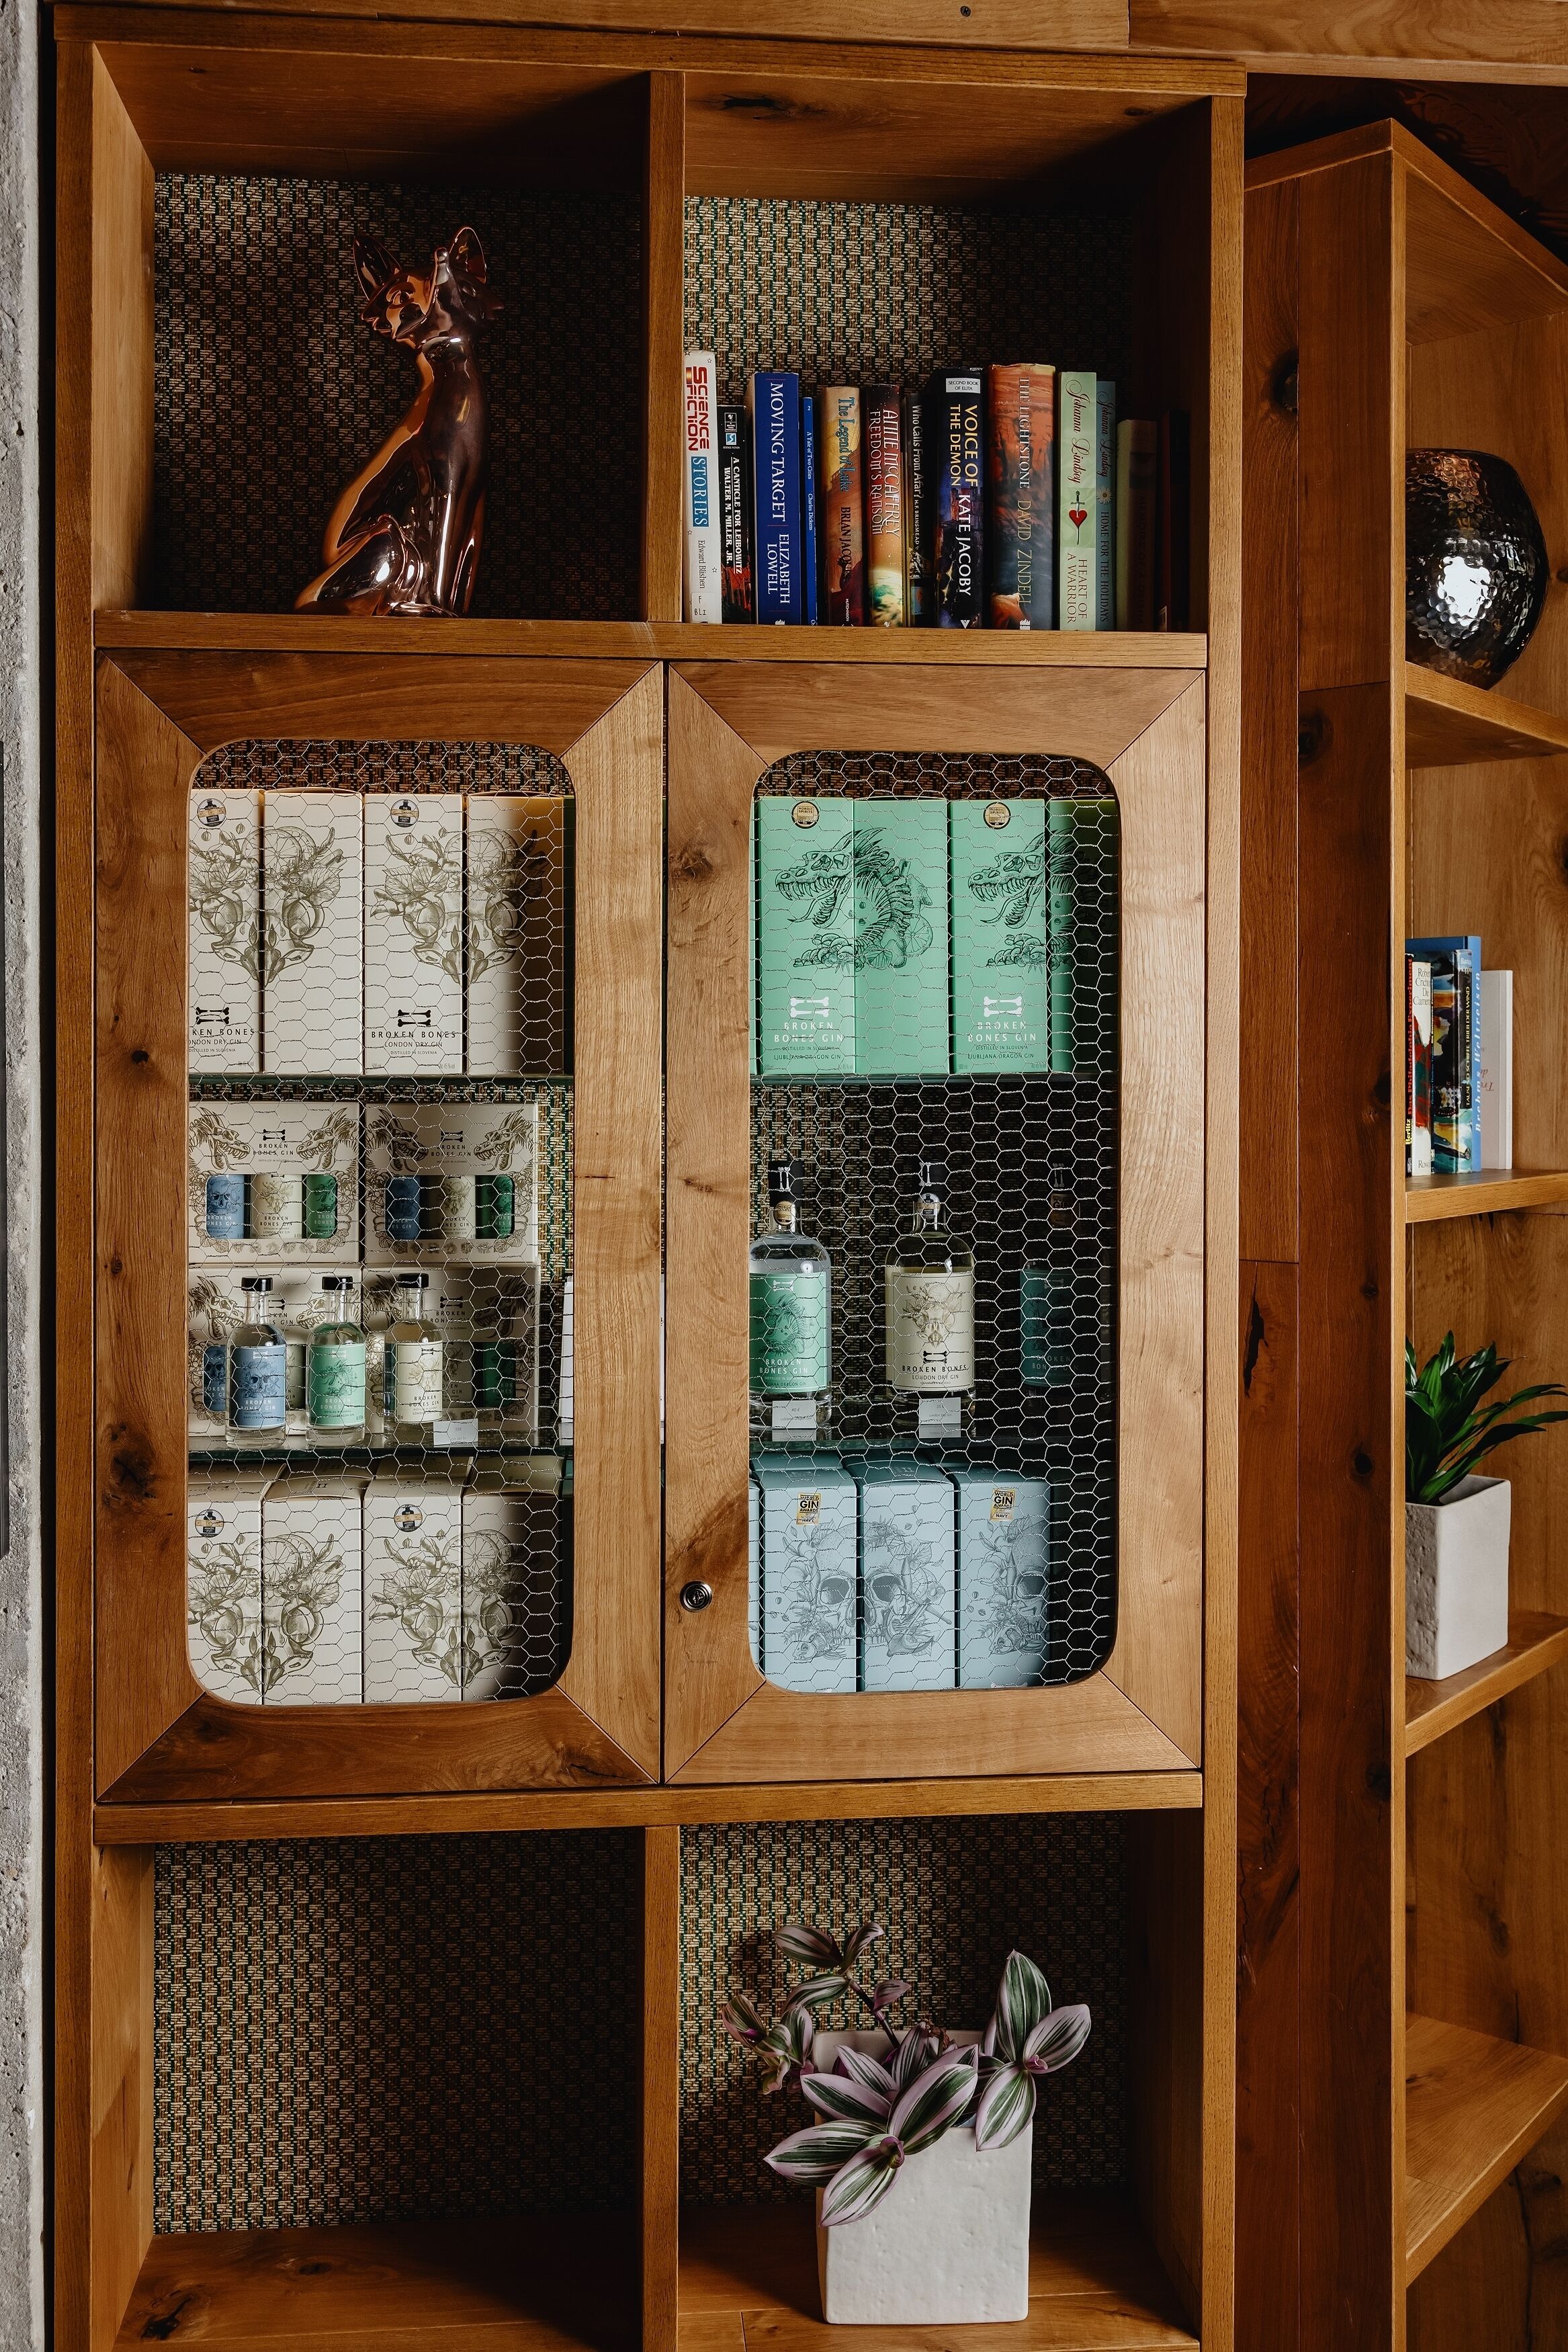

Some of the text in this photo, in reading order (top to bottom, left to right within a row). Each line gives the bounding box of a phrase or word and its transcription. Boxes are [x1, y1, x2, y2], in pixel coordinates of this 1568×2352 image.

[771, 382, 785, 522] MOVING TARGET
[835, 396, 855, 492] The Legend of Luke
[883, 409, 900, 449] ANNIE
[912, 405, 924, 499] Who Calls From Afar?
[950, 404, 961, 486] THE DEMON
[965, 405, 978, 487] VOICE OF
[1019, 377, 1031, 489] THE LIGHTSTONE
[1065, 380, 1090, 484] Johanna Lindsey
[1096, 391, 1115, 478] Johanna Lindsey
[733, 465, 741, 507] CANTICLE
[869, 411, 883, 535] FREEDOM'S RANSOM
[725, 503, 732, 513] M.
[734, 509, 742, 526] FOR
[840, 507, 851, 537] BRIAN
[725, 549, 733, 564] JR.
[734, 529, 742, 574] LEIBOWITZ
[767, 544, 778, 595] LOWELL
[779, 534, 790, 604] ELIZABETH
[955, 495, 971, 596] KATE JACOBY
[1017, 500, 1033, 606] DAVID ZINDELL
[1100, 512, 1109, 623] HOME FOR THE HOLIDAYS
[699, 565, 707, 589] Blishen
[1067, 564, 1077, 624] WARRIOR
[1078, 559, 1088, 619] HEART OF
[774, 1034, 842, 1042] BONES GIN
[968, 1033, 1036, 1042] BONES GIN
[977, 1021, 1026, 1030] BROKEN
[799, 1500, 819, 1509] GIN
[994, 1496, 1012, 1505] GIN
